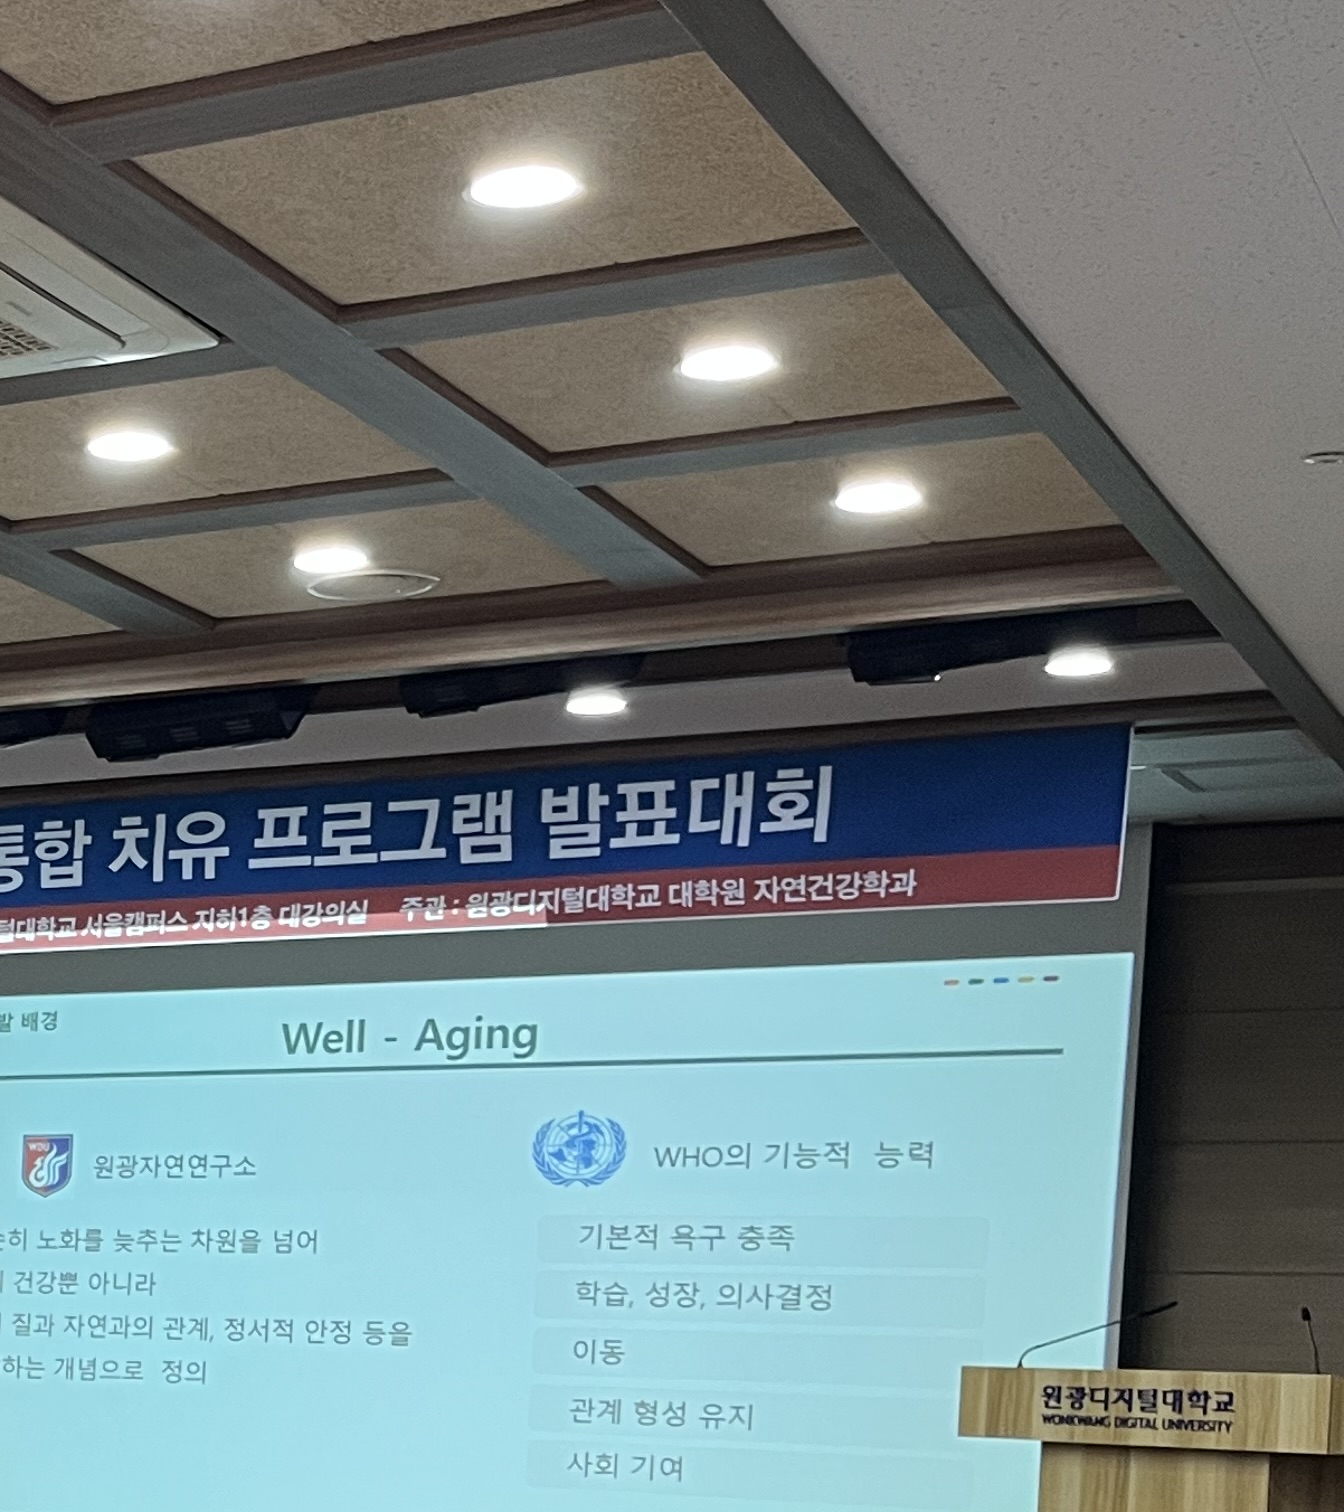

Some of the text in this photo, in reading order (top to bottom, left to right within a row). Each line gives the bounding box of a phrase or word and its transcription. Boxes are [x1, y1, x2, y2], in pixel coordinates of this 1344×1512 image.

[109, 811, 230, 883] 치유
[248, 790, 513, 870] 프로그램
[541, 766, 833, 859] 발표대회
[399, 896, 446, 922] 주관
[465, 885, 662, 920] 원광디지털대학교
[668, 878, 745, 911] 대학원
[753, 869, 917, 907] 자연건강학과
[82, 912, 188, 940] 서울캠퍼스
[195, 904, 274, 931] 지하1층
[279, 899, 369, 927] 대강의실
[21, 1011, 59, 1031] 배경
[282, 1019, 366, 1056] Well
[414, 1014, 540, 1061] Aging
[93, 1153, 256, 1181] 원광자연연구소
[654, 1139, 936, 1172] WHO의 기능적 능력
[36, 1227, 104, 1254] 노화를
[113, 1228, 182, 1255] 늦추는
[191, 1229, 262, 1255] 차원을
[272, 1229, 319, 1255] 넘어
[579, 1223, 797, 1253] 기본적 욕구 충족
[13, 1271, 79, 1296] 건강뿐
[88, 1271, 157, 1297] 아니라
[575, 1279, 834, 1313] 학습, 성장, 의사결정
[11, 1313, 55, 1339] 질과
[63, 1313, 154, 1341] 자연과의
[163, 1316, 215, 1345] 관계,
[223, 1317, 294, 1345] 정서적
[304, 1318, 352, 1346] 안정
[362, 1320, 413, 1347] 등을
[572, 1338, 626, 1367] 이동
[54, 1356, 144, 1383] 개념으로
[161, 1359, 208, 1386] 정의
[569, 1397, 755, 1432] 관계 형성 유지
[1041, 1385, 1236, 1416] 원광디지털대학교
[1041, 1413, 1233, 1434] WONKWANG DIGITAL UNIVERSITY
[567, 1452, 685, 1483] 사회 기여
